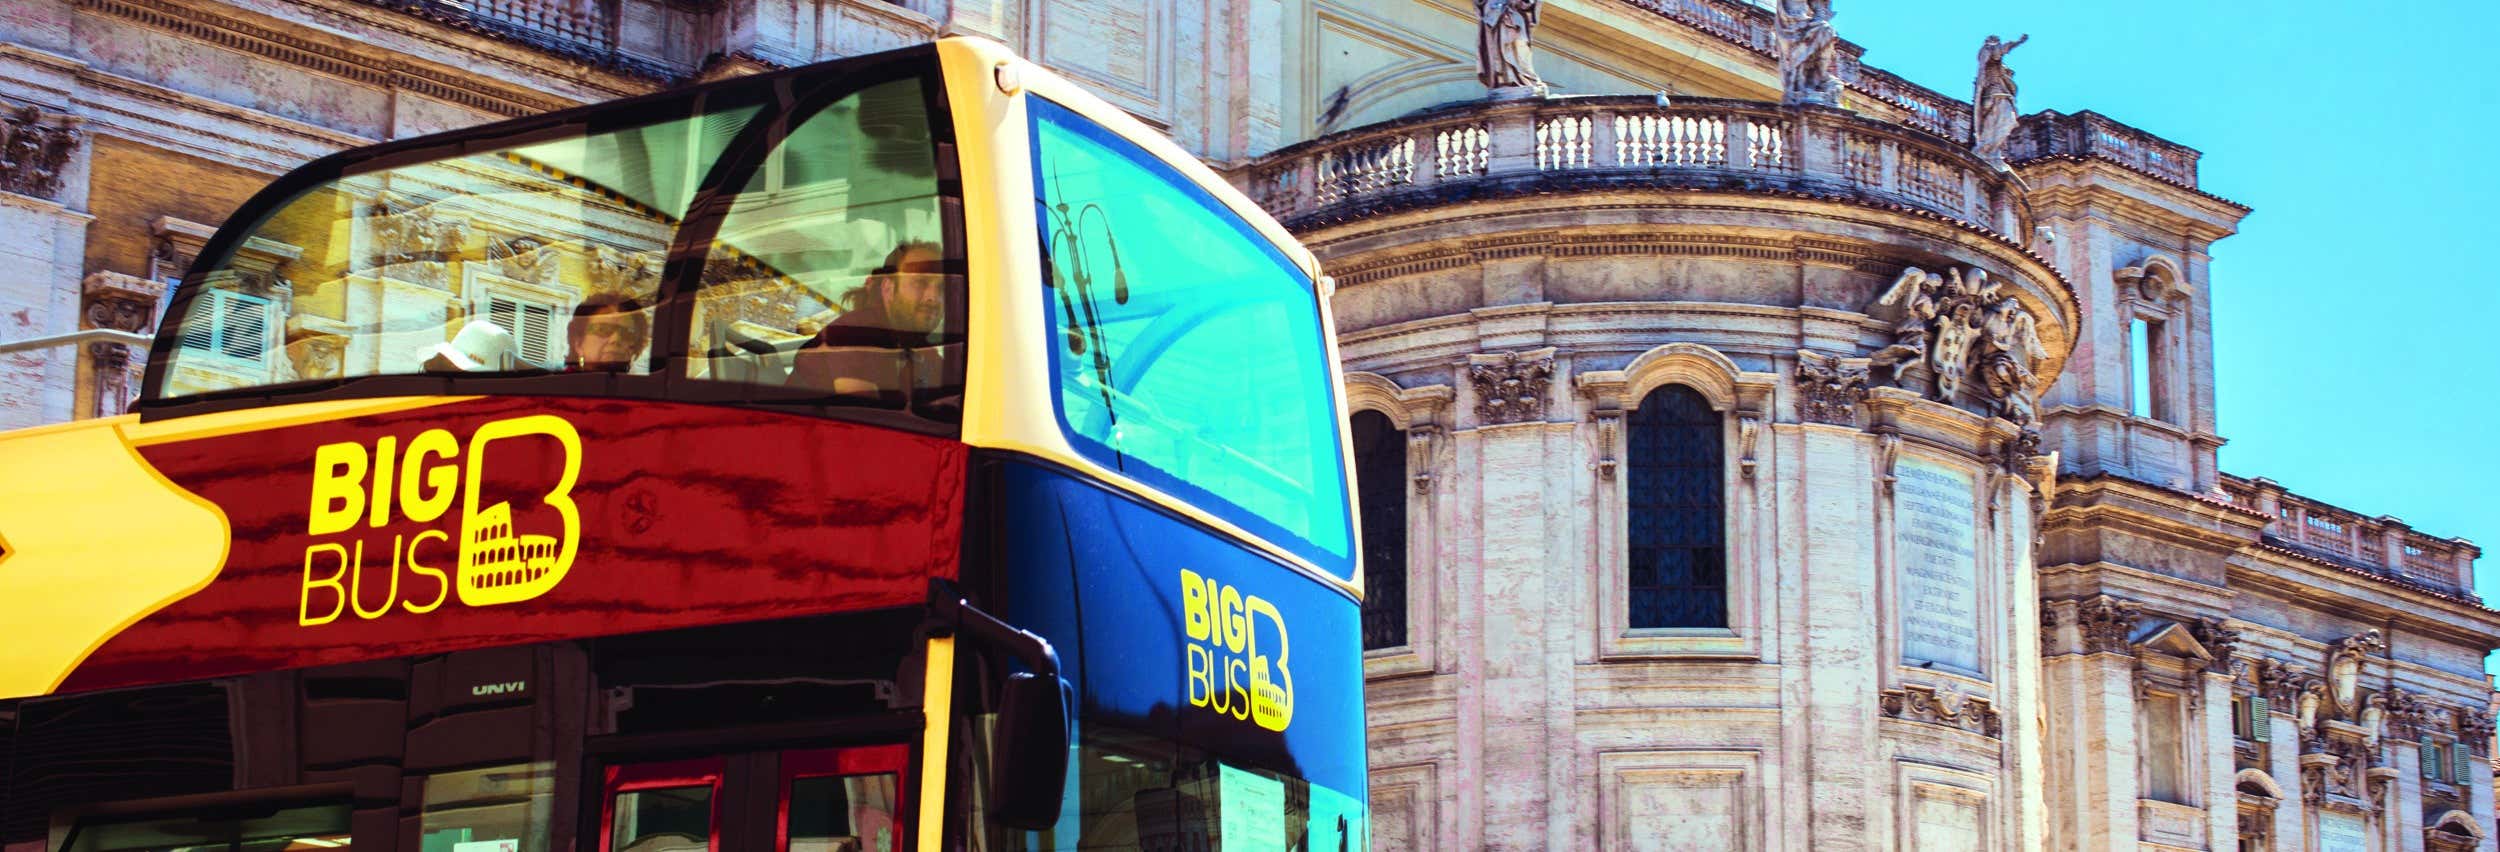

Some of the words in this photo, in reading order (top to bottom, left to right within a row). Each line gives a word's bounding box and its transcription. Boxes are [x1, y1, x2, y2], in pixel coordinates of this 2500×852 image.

[308, 428, 460, 536] BIG
[299, 529, 449, 627] BUS
[1180, 568, 1246, 654] BIG
[472, 680, 525, 696] UNVI
[1187, 642, 1250, 721] BUS
